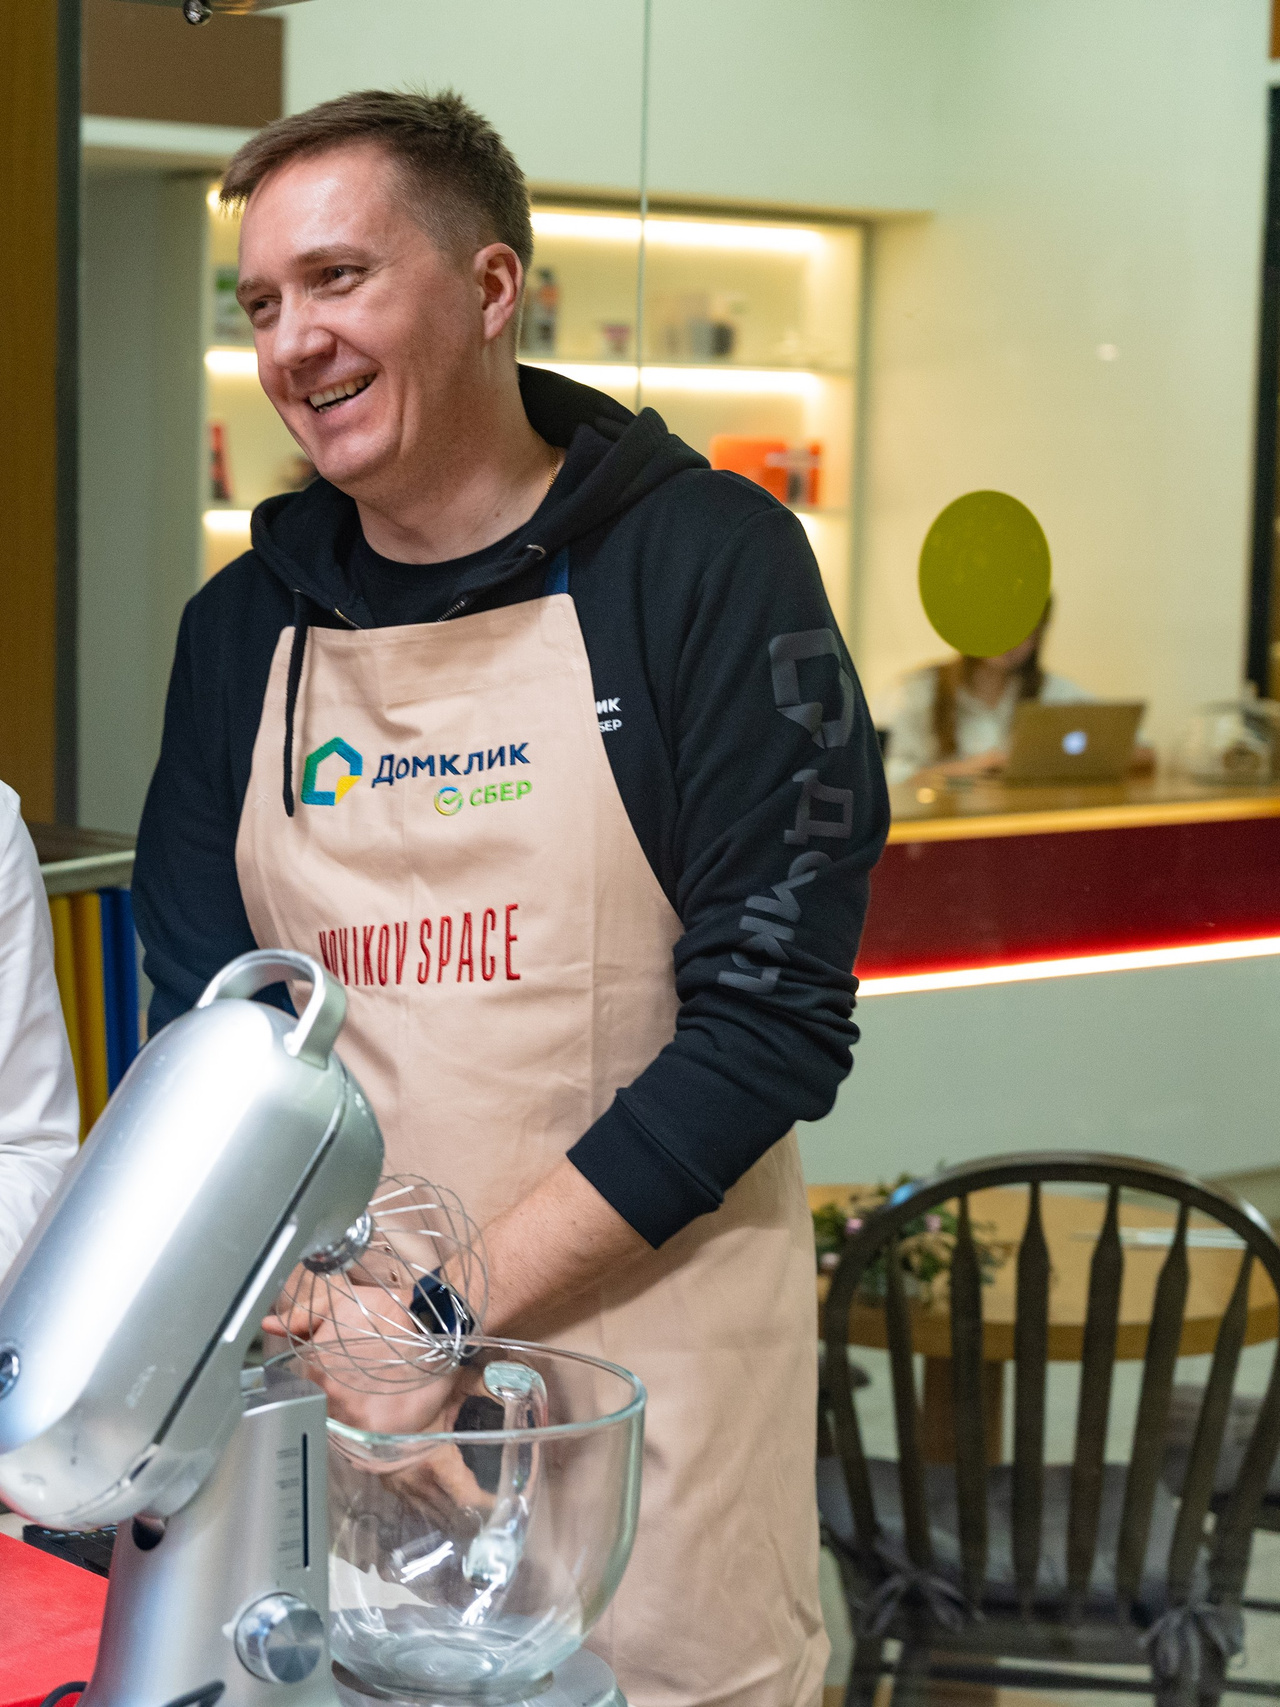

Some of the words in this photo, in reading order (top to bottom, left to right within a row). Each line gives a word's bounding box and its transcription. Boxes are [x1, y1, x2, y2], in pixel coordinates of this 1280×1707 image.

[598, 718, 623, 733] БЕР
[469, 779, 533, 806] СБЕР
[417, 903, 521, 985] SPACE
